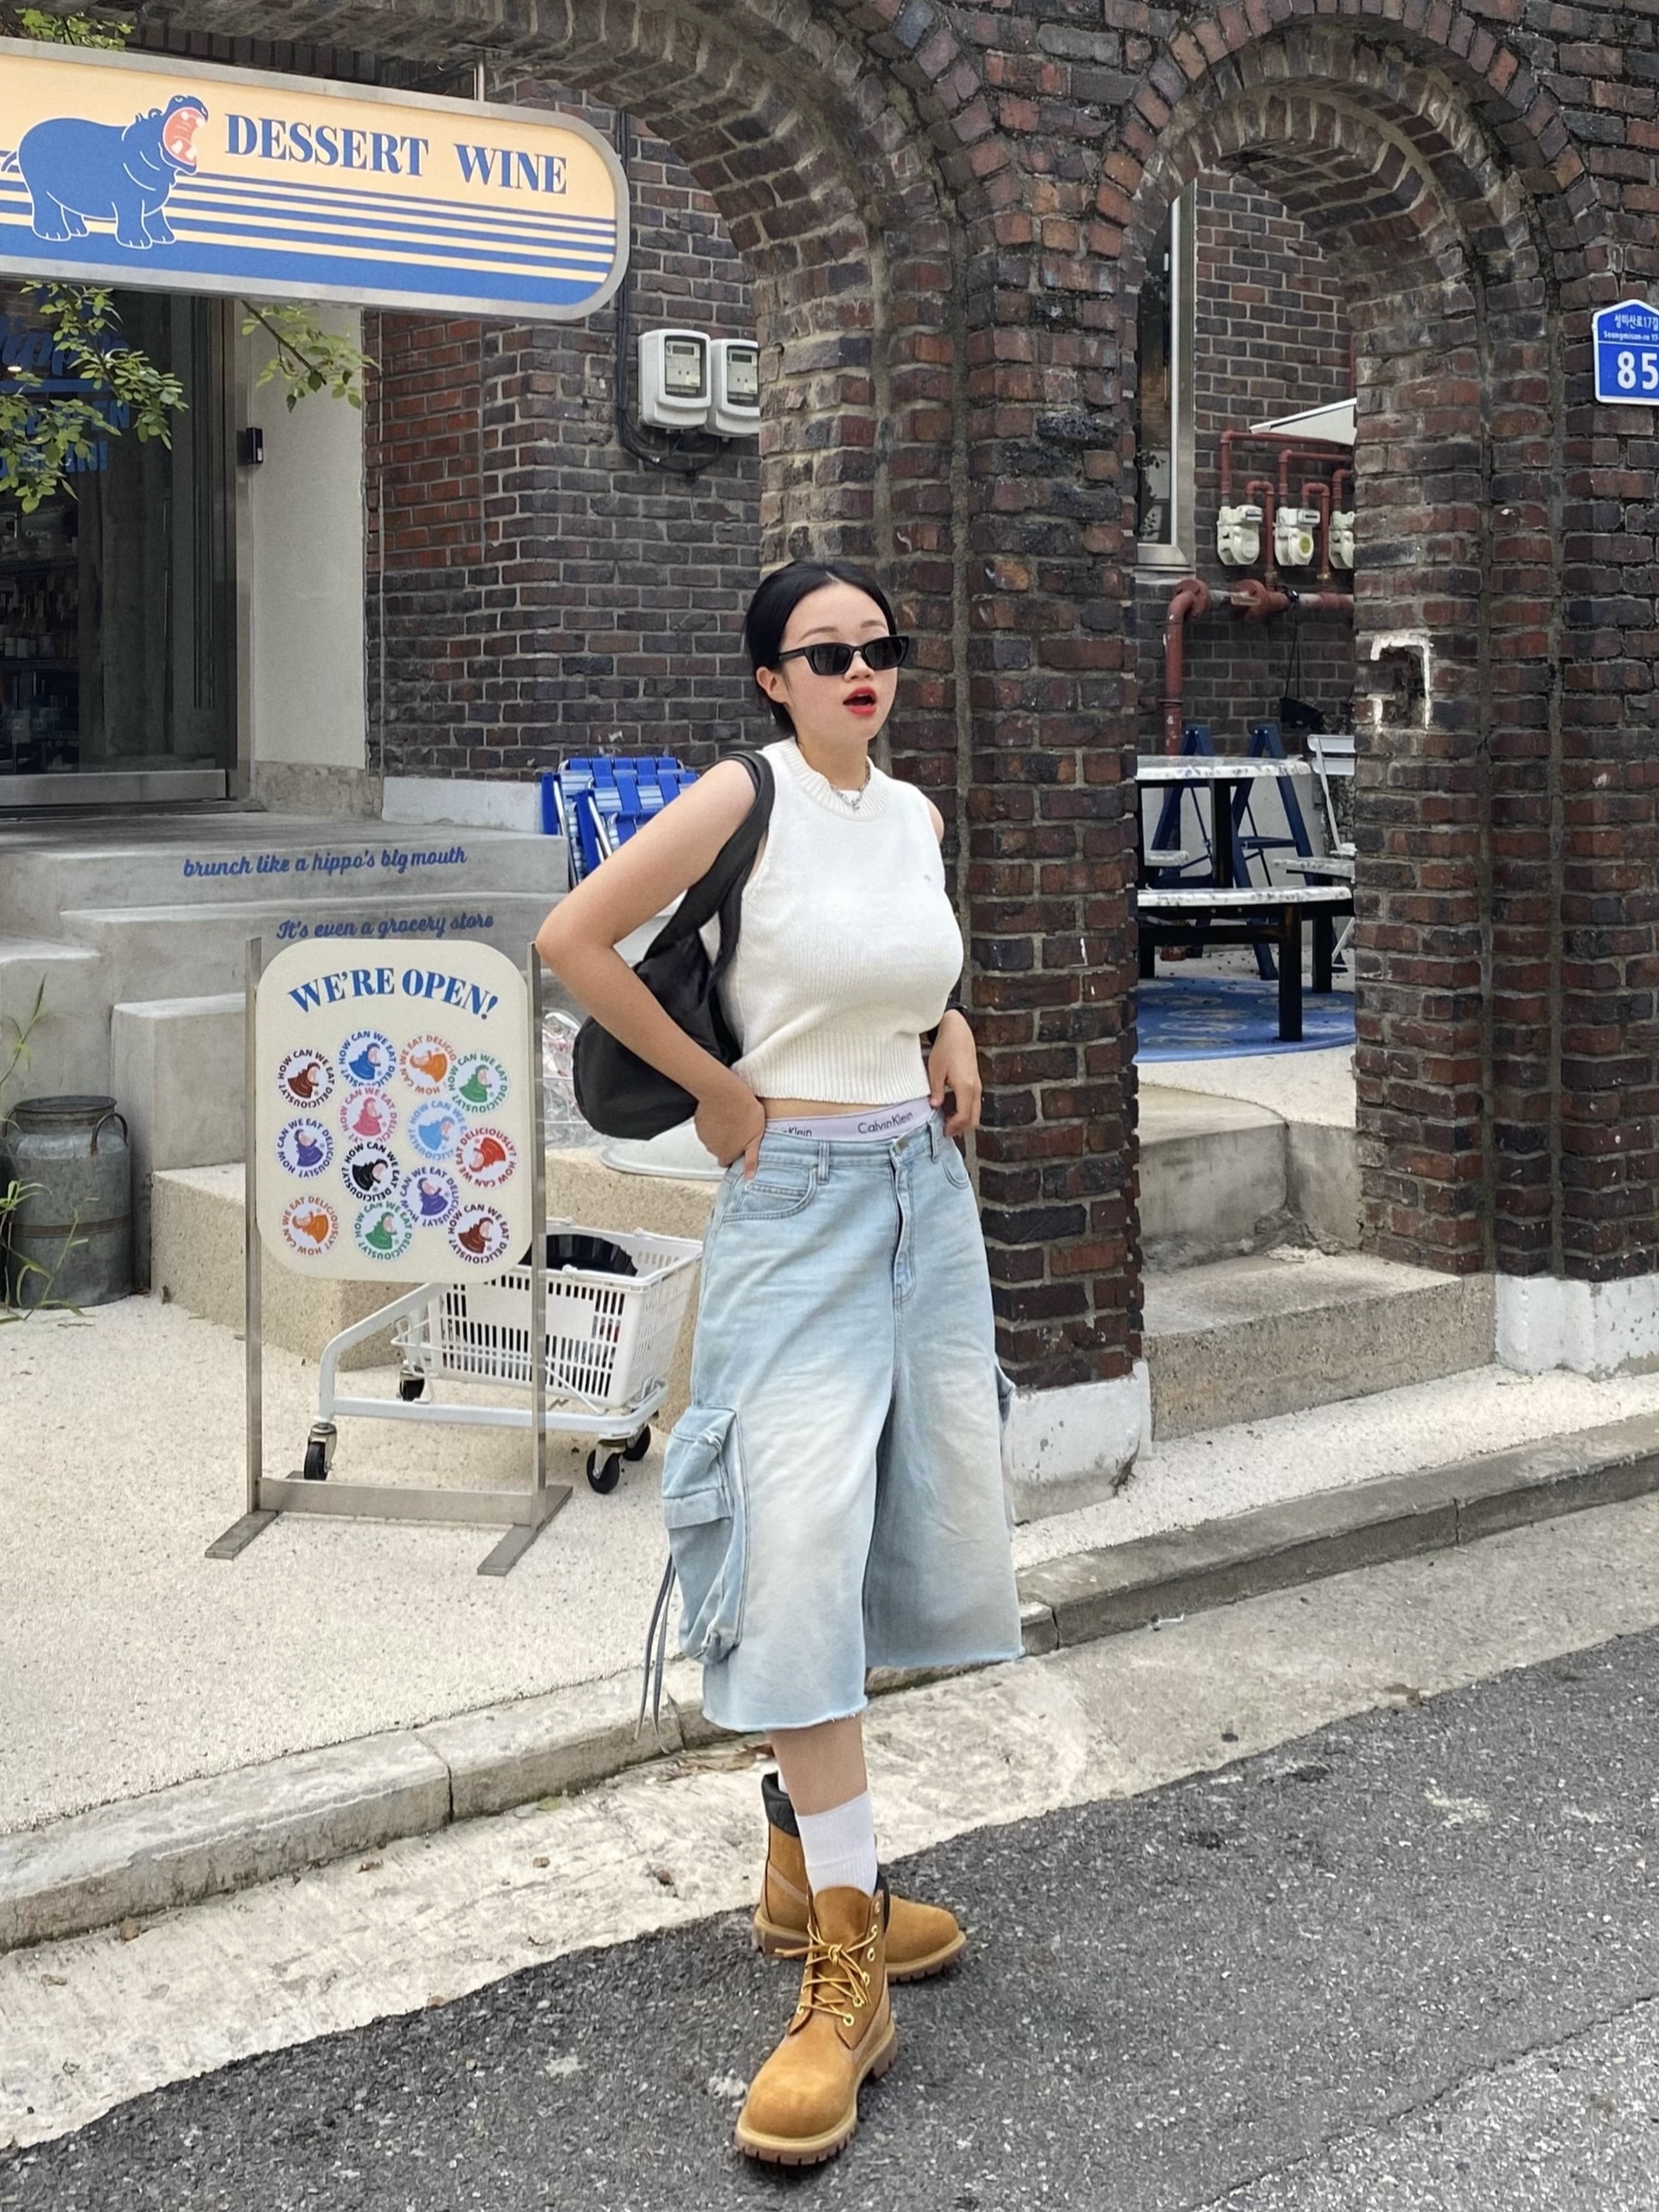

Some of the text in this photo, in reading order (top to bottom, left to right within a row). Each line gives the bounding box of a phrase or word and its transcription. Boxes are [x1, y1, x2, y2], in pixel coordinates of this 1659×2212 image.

[225, 113, 567, 195] DESSERT WINE
[1617, 351, 1658, 390] 85
[184, 846, 468, 877] brunch like a hippo's big mouth
[276, 912, 493, 939] It's even a grocery store
[287, 967, 499, 1020] WE'RE OPEN!
[339, 1040, 351, 1065] HOW
[351, 1030, 370, 1041] CAN
[374, 1031, 388, 1045] WE
[386, 1045, 396, 1063] EAT
[399, 1049, 410, 1065] WE
[407, 1035, 423, 1050] EAT
[278, 1049, 334, 1108] HOW CAN WE EAT DELICIOUSLY?
[400, 1068, 414, 1087] CAN
[415, 1085, 440, 1094] HOW
[448, 1053, 508, 1113] HOW CAN WE EAT DELICIOUSLY?
[339, 1106, 350, 1131] HOW
[345, 1088, 362, 1104] CAN
[365, 1087, 381, 1095] WE
[381, 1093, 395, 1109] EAT
[410, 1102, 428, 1124] HOW
[431, 1100, 452, 1111] CAN
[452, 1107, 466, 1124] WE
[277, 1118, 334, 1178] HOW CAN WE EAT DELICIOUSLY?
[460, 1127, 517, 1156] DELICIOUSLY?
[341, 1141, 400, 1202] HOW CAN WE EAT DELICIOUSLY?
[399, 1177, 412, 1197] CAN
[411, 1166, 427, 1177] WE
[429, 1166, 448, 1178] EAT
[459, 1165, 472, 1182] WE
[475, 1178, 496, 1188] CAN
[498, 1160, 517, 1184] HOW
[386, 1200, 401, 1213] WE
[400, 1212, 412, 1230] EAT
[282, 1195, 339, 1256] HOW CAN WE EAT DELICIOUSLY?
[354, 1212, 365, 1238] HOW
[448, 1204, 510, 1265] HOW CAN WE EAT DELICIOUSLY?
[358, 1232, 412, 1260] DELICIOUSLY?
